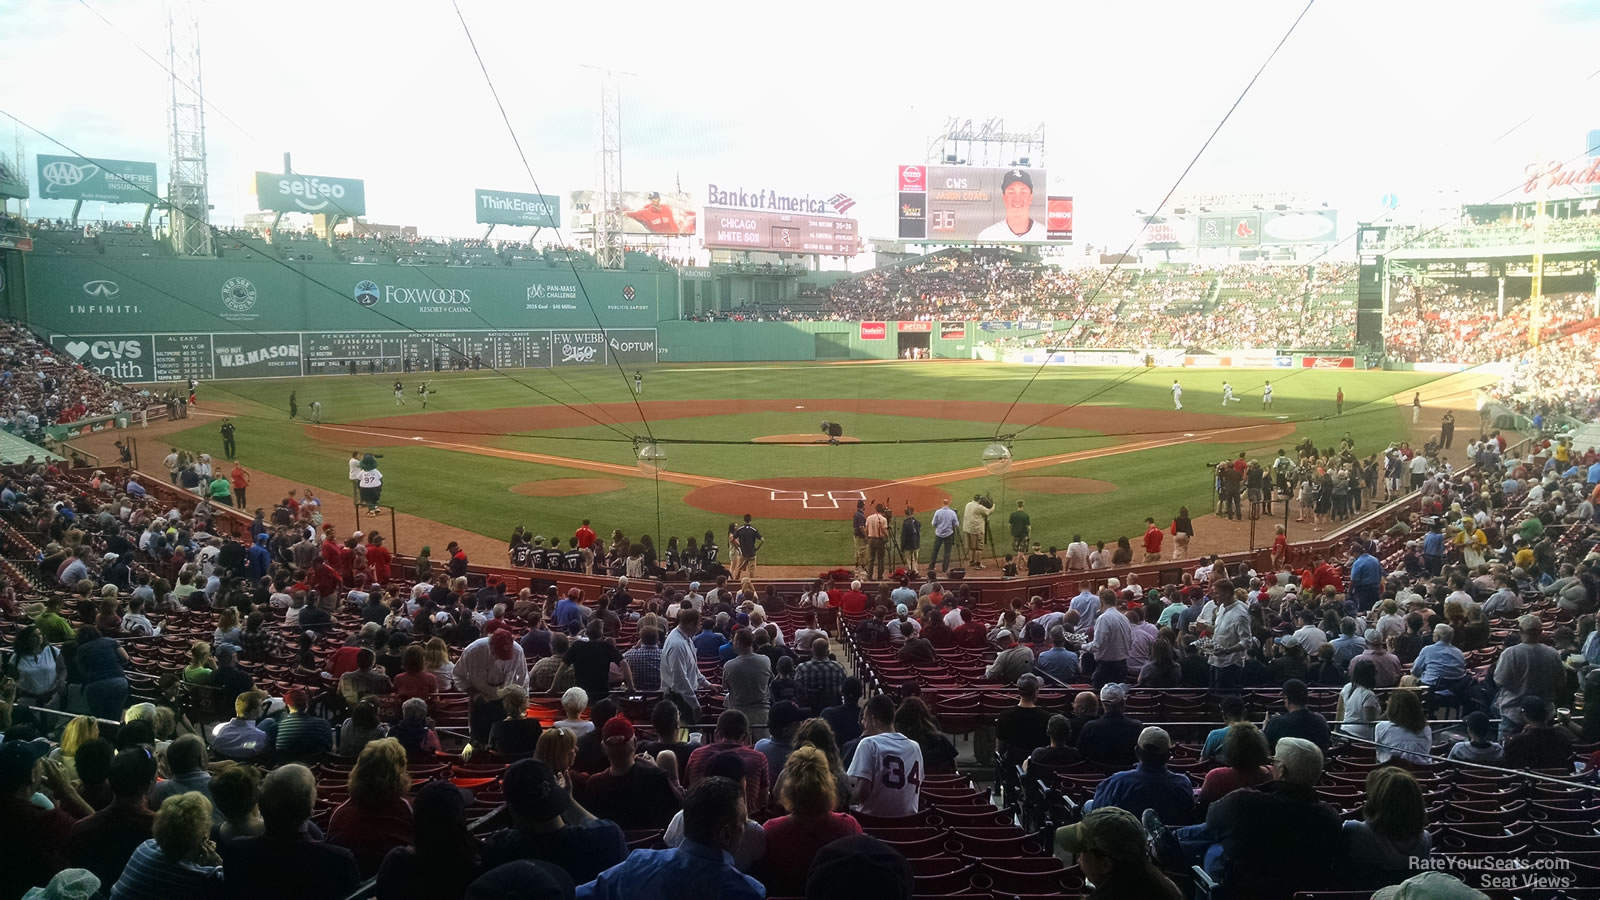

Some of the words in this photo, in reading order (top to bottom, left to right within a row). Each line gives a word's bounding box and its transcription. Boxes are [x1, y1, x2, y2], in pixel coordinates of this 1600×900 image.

[47, 163, 76, 185] AAA
[946, 178, 968, 189] CWS
[708, 183, 747, 207] Bank
[750, 189, 766, 208] of
[767, 190, 825, 214] America
[935, 192, 960, 200] JASON
[480, 196, 553, 216] ThinkEnergy
[720, 218, 757, 229] CHICAGO
[932, 211, 955, 230] 36
[718, 231, 742, 242] WHITE
[744, 232, 760, 243] SOX
[384, 285, 471, 304] FOXWOODS
[574, 333, 604, 343] WEBB
[91, 340, 142, 359] CVS
[620, 342, 654, 351] OPTUM
[364, 476, 375, 484] 97
[201, 553, 215, 565] 24
[707, 549, 716, 560] 17
[568, 558, 577, 568] 17
[882, 754, 920, 794] 34
